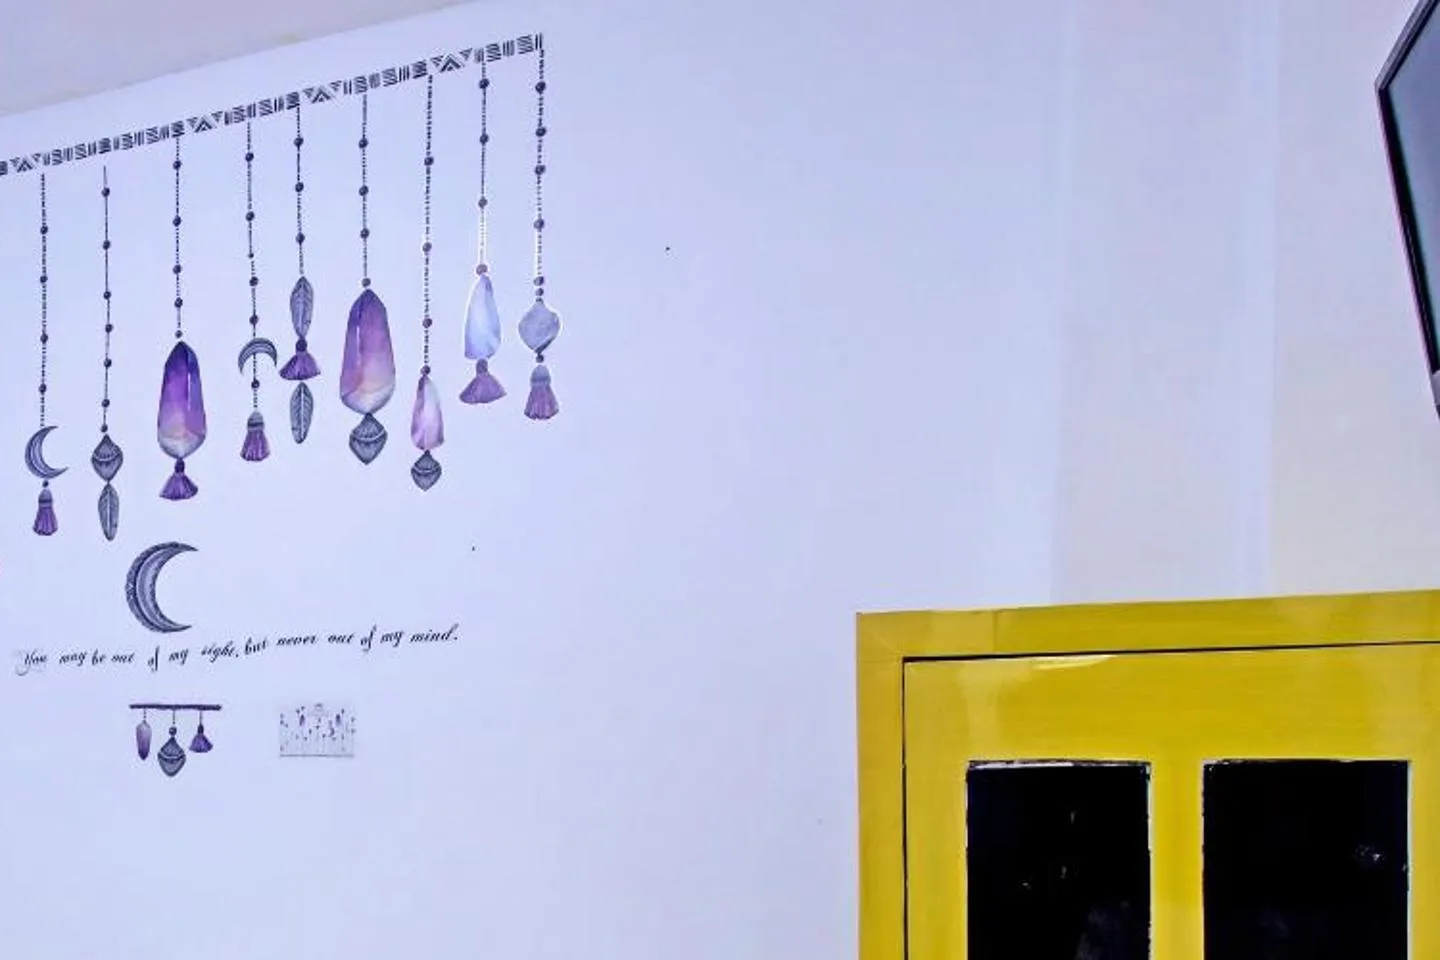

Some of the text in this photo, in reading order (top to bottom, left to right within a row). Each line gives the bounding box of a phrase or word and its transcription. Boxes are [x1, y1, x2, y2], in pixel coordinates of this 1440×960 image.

[58, 651, 87, 667] may
[91, 649, 106, 666] be
[110, 652, 136, 664] out
[147, 645, 160, 673] of
[168, 648, 189, 666] my
[244, 636, 268, 656] but
[276, 635, 319, 646] never
[327, 632, 355, 644] out
[360, 623, 377, 653] of
[380, 631, 405, 648] my
[409, 622, 459, 643] mind.
